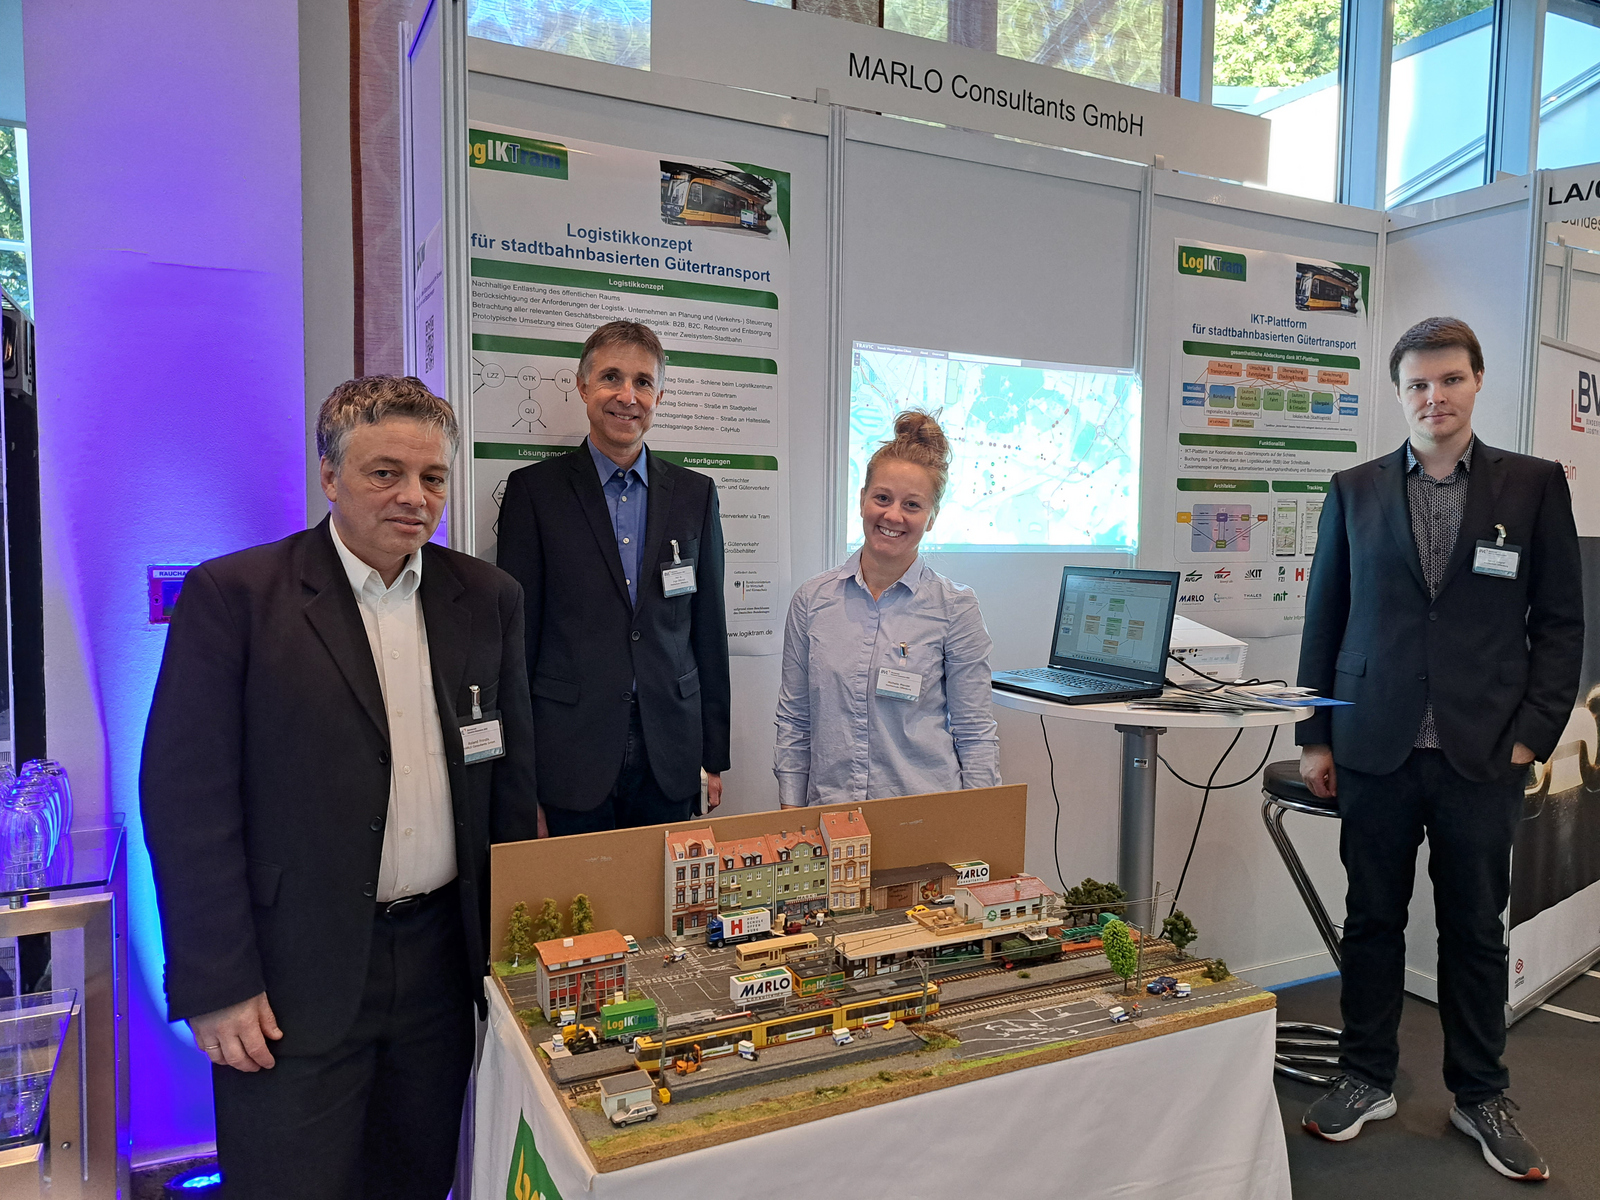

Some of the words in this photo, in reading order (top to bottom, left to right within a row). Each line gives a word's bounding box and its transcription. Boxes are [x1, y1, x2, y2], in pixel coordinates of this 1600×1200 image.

[849, 52, 943, 94] MARLO
[951, 74, 1076, 122] Consultants
[1083, 104, 1144, 137] GmbH
[566, 223, 693, 253] Logistikkonzept
[470, 232, 496, 249] für
[501, 238, 660, 268] stadtbahnbasierten
[664, 256, 771, 283] Gütertransport
[1182, 252, 1242, 274] LogIKTram
[472, 280, 511, 291] Nachhaltige
[513, 284, 547, 295] Entlastung
[548, 287, 561, 295] des
[561, 287, 597, 299] öffentlichen
[598, 293, 621, 302] Raums
[608, 278, 665, 292] Logistikkonzept
[472, 290, 528, 304] Berücksichtigung
[529, 296, 541, 304] der
[541, 297, 588, 310] Anforderungen
[589, 301, 600, 310] der
[628, 306, 668, 318] Unternehmen
[678, 311, 702, 321] Planung
[703, 313, 714, 321] und
[746, 318, 773, 328] Steuerung
[472, 301, 513, 313] Betrachtung
[529, 308, 563, 317] relevanten
[564, 310, 622, 322] Geschäftsbereiche
[703, 324, 729, 333] Retouren
[741, 328, 772, 338] Entsorgung
[472, 312, 517, 323] Prototypische
[519, 317, 555, 328] Umsetzung
[556, 319, 574, 328] eines
[680, 332, 742, 343] Zweisystem-Stadtbahn
[1250, 313, 1307, 330] IKT-Plattform
[1192, 323, 1206, 335] für
[1208, 326, 1294, 343] stadtbahnbasierten
[1297, 333, 1357, 350] Gütertransport
[711, 391, 737, 399] Gütertram
[735, 382, 773, 390] Logistikzentrum
[729, 404, 757, 412] Stadtgebiet
[518, 449, 569, 458] Lösungsmo
[683, 456, 731, 465] Ausprägungen
[1250, 569, 1262, 578] KIT
[1179, 594, 1205, 603] MARLO
[727, 629, 773, 639] ww.logiktram.de
[740, 977, 790, 998] MARLO
